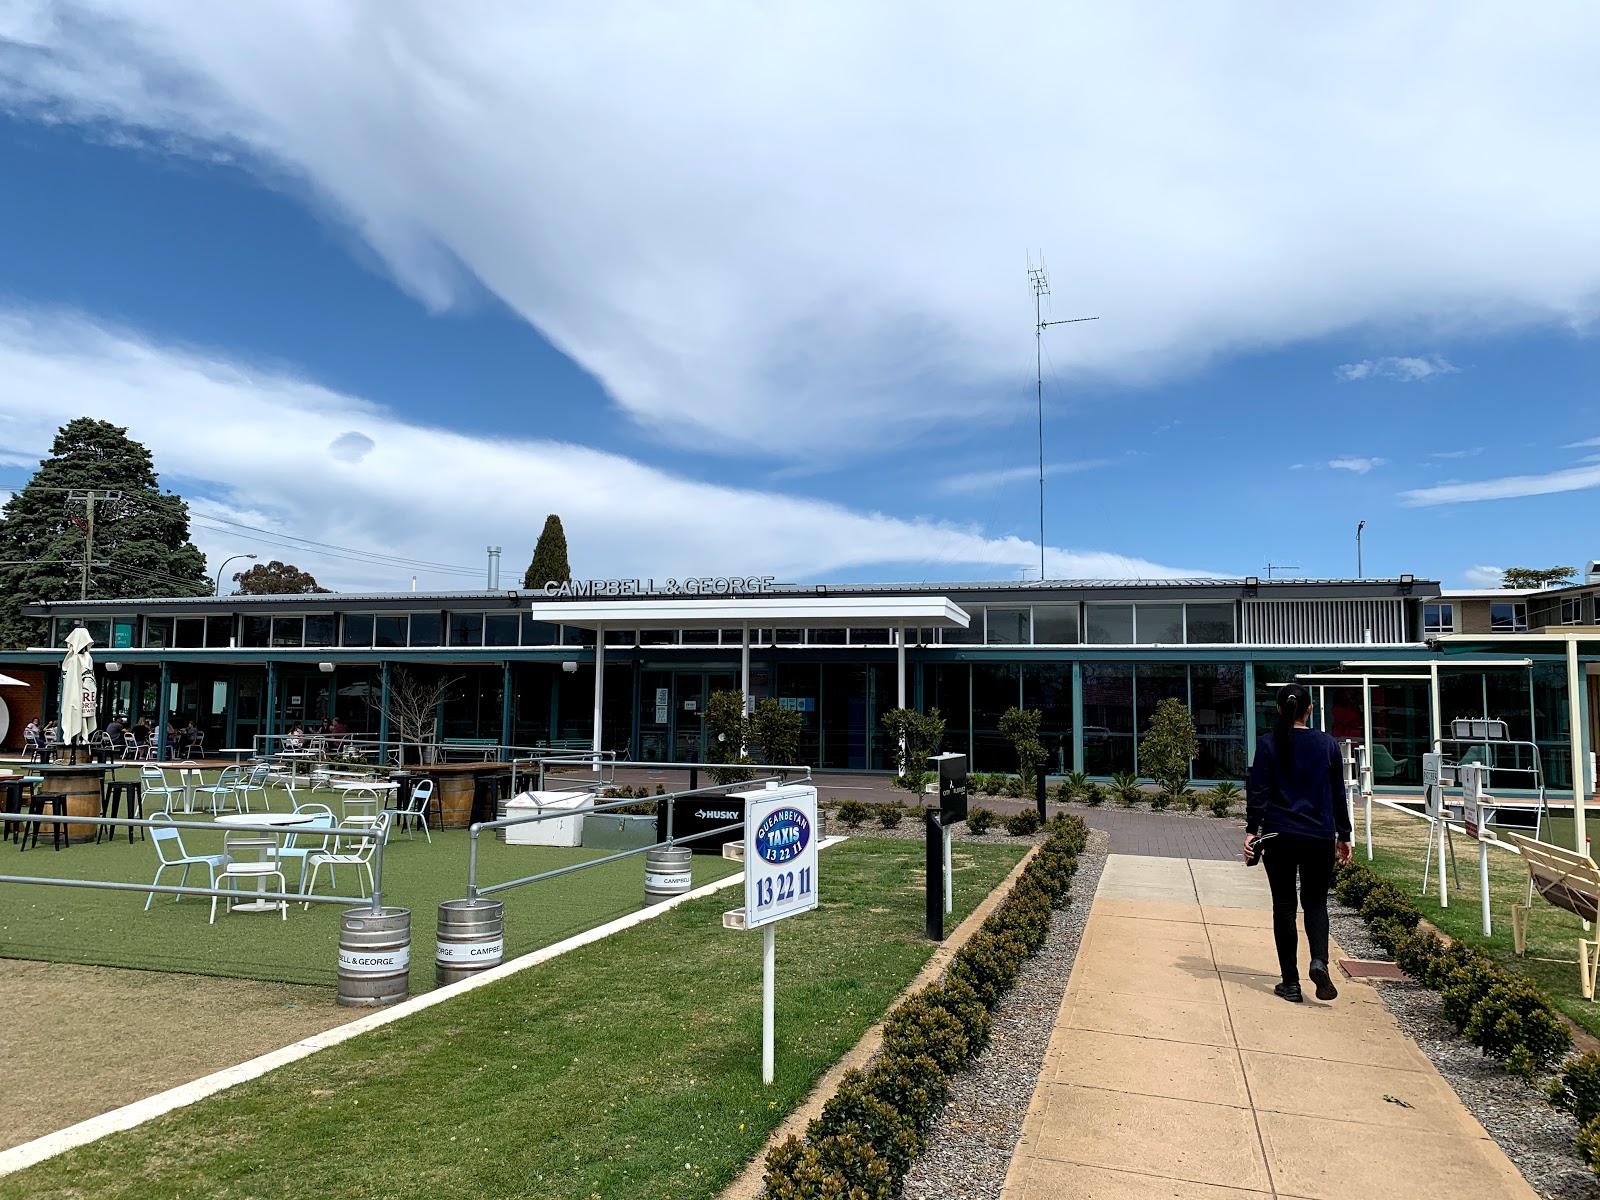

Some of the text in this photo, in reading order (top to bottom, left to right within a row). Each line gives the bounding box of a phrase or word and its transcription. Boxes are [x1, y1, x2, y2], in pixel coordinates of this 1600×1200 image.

[544, 576, 774, 597] CAMPBELL & GEORGE
[706, 810, 739, 820] HUSKY
[758, 810, 807, 839] QUEANBEYAN
[768, 826, 800, 847] TAXIS
[765, 841, 803, 861] 13 22 11
[756, 865, 811, 908] 13 22 11
[352, 957, 358, 965] &
[358, 957, 394, 966] GEORGE
